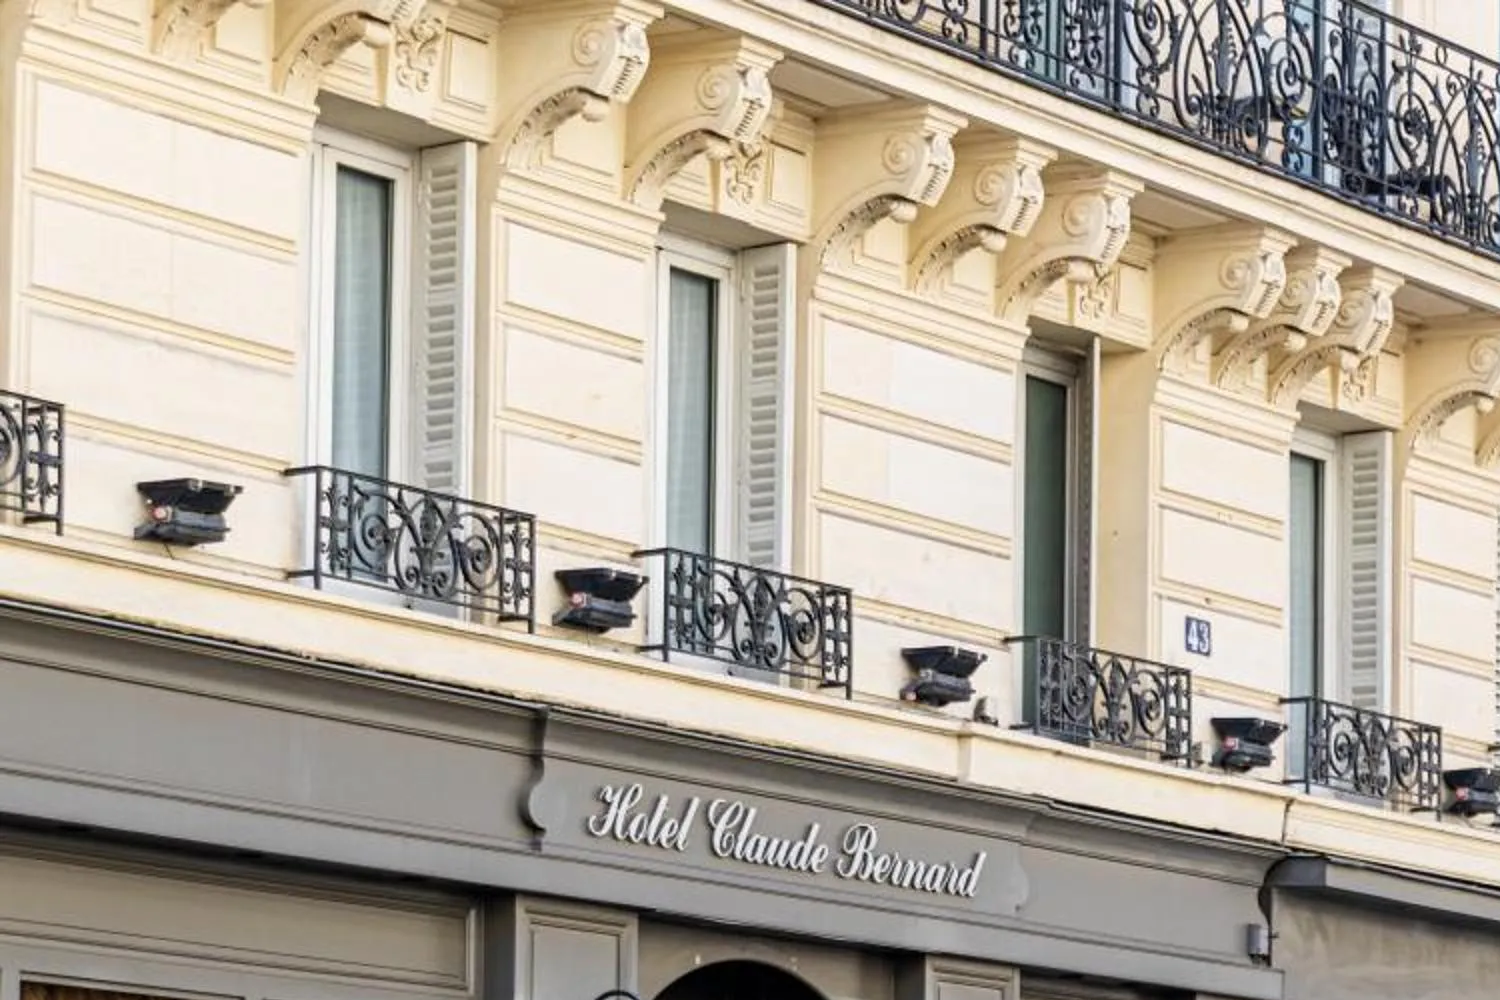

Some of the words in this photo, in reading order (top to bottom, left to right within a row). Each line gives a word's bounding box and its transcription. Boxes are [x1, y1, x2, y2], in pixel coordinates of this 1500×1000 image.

[1188, 620, 1209, 653] 43
[590, 784, 701, 851] Hotel
[708, 798, 830, 873] Claude
[836, 822, 987, 898] Bernard
